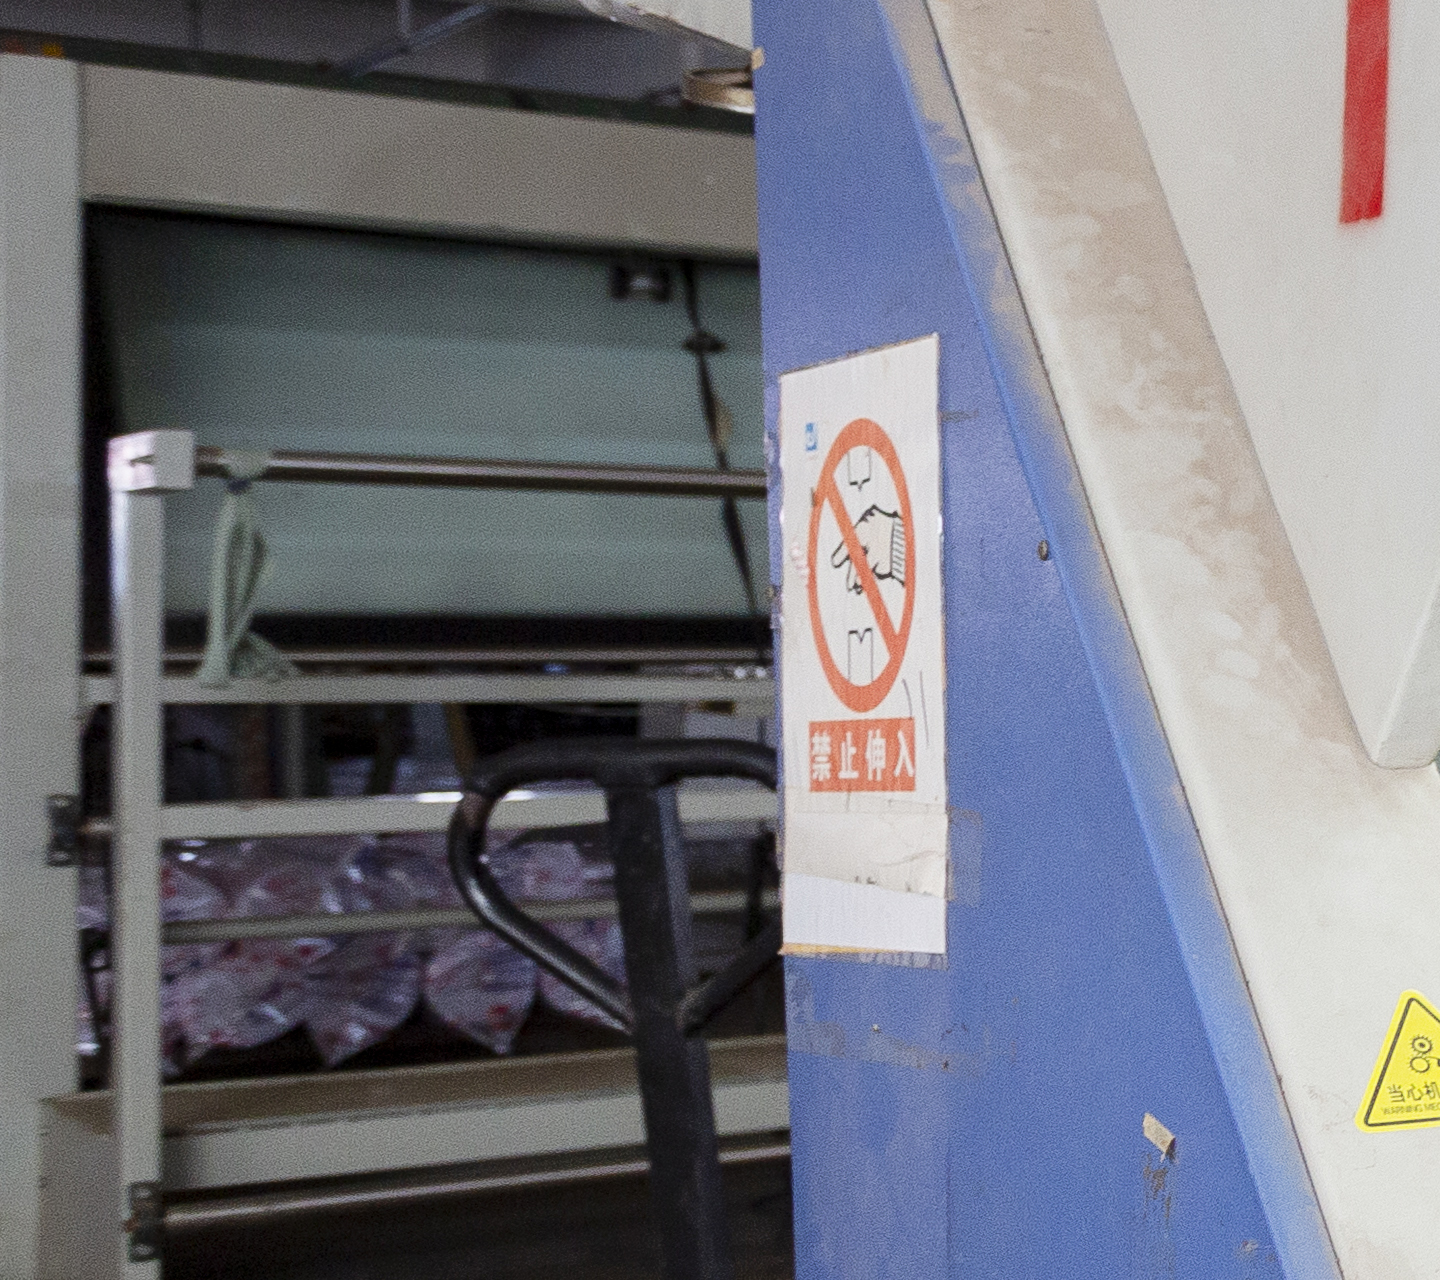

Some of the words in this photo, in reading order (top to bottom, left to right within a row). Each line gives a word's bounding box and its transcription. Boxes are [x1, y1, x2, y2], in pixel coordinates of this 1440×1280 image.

[811, 729, 915, 782] 禁止伸入
[1382, 1103, 1424, 1115] WARNING
